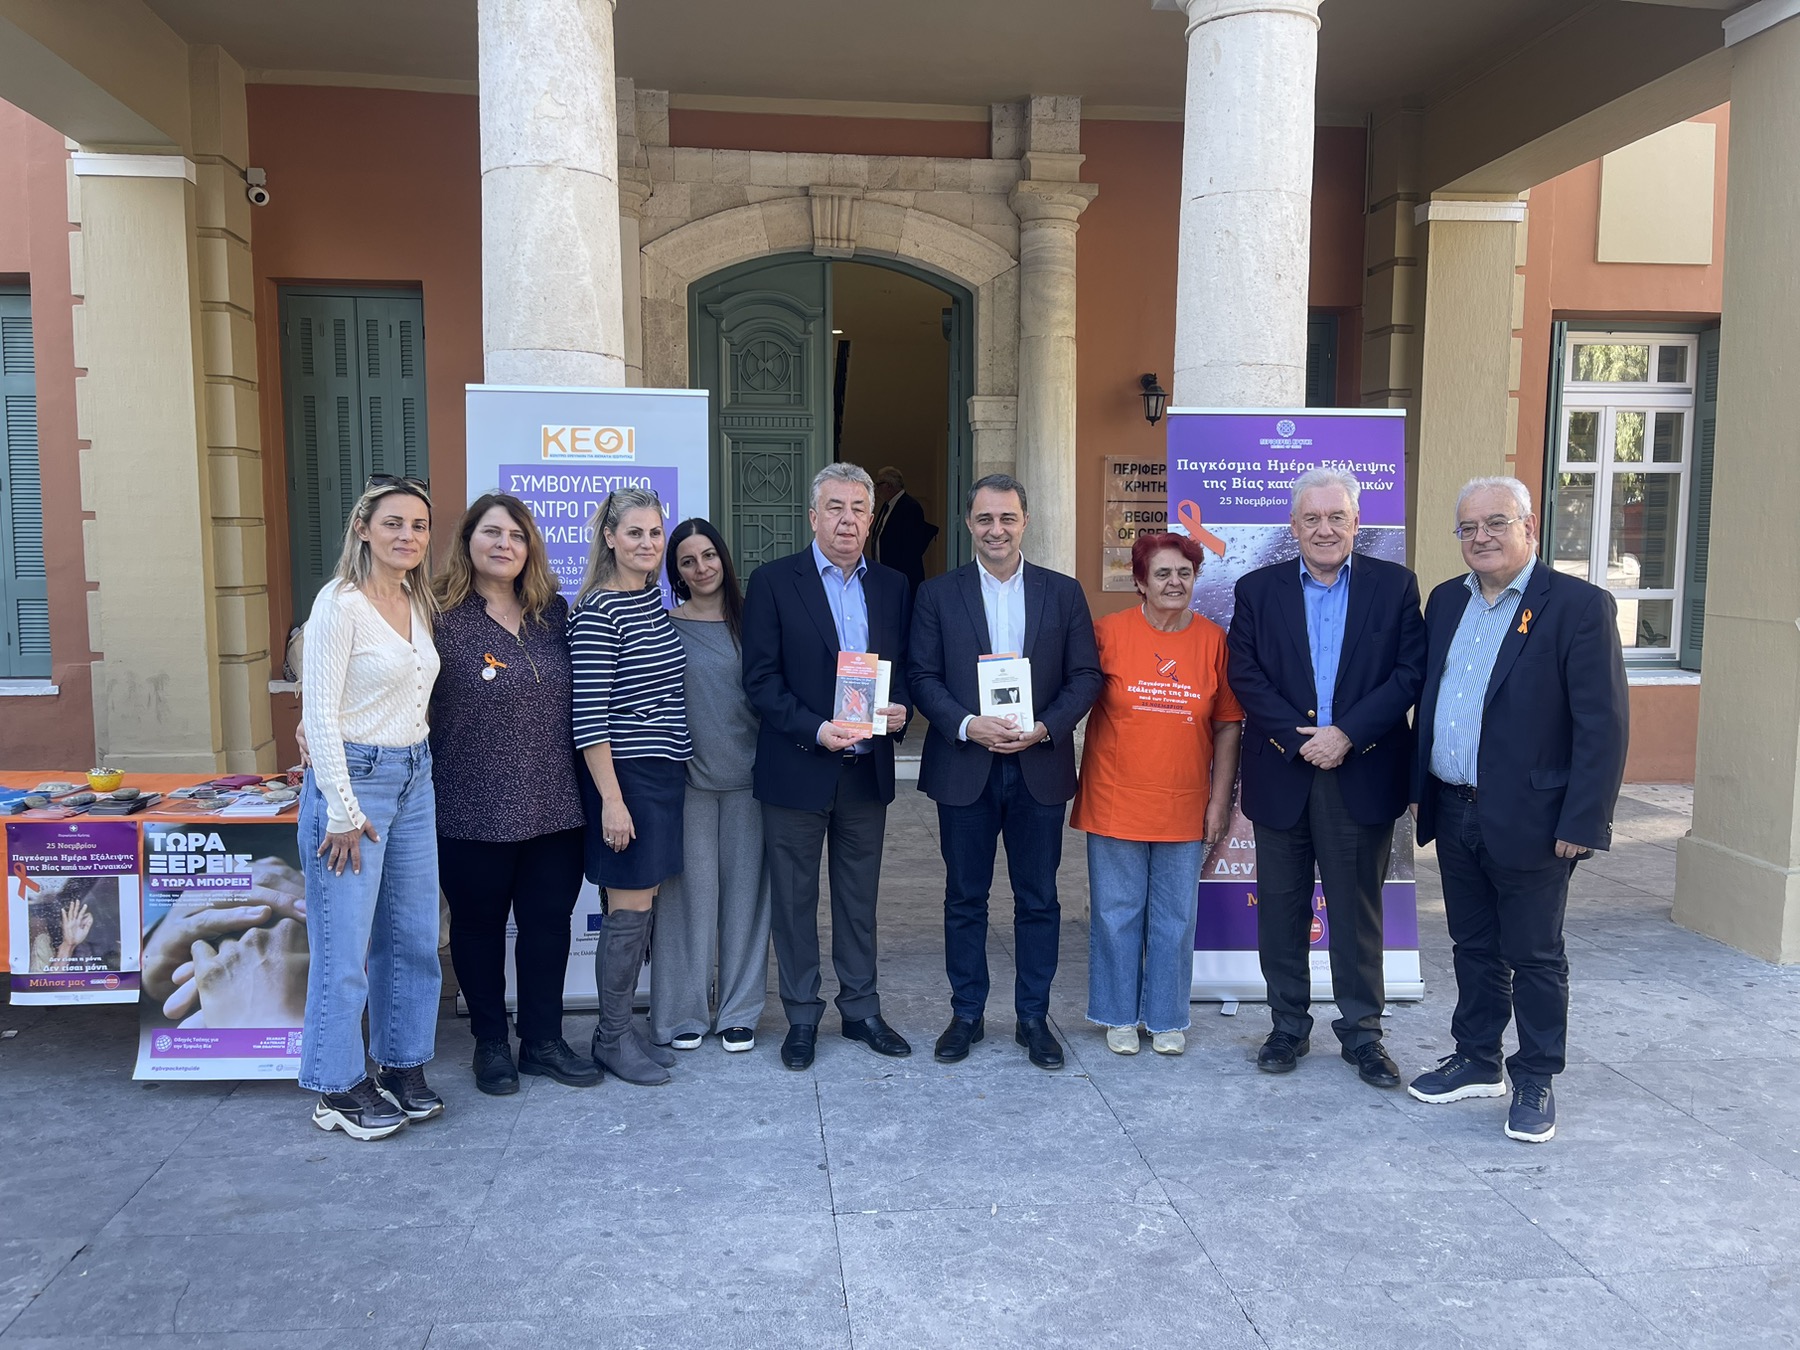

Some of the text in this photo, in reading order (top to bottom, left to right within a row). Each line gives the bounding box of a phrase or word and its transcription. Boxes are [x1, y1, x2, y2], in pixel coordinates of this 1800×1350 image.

[1114, 464, 1167, 475] ΠΕΡΙΦΕΡ
[1176, 459, 1395, 474] Παγκόσμια Ημέρα Εξάλειψης
[510, 475, 650, 492] ΣΥΜΒΟΥΛΕΥΤΙΚΟ
[1125, 481, 1167, 492] ΚΡΗΤΗ
[1203, 480, 1227, 491] της
[1232, 478, 1264, 491] Βίας
[1220, 497, 1288, 507] 25 Νοεμβρίου
[524, 501, 578, 518] ΕΝΤΡΟ
[1118, 528, 1134, 539] OF
[550, 567, 584, 575] 341387
[1128, 686, 1166, 696] Εξάλειψης
[149, 833, 226, 852] ΤΩΡΑ
[149, 854, 252, 873] ΞΕΡΕΙΣ
[1214, 859, 1254, 874] Δεν
[197, 878, 250, 886] ΜΠΟΡΕΙΣ
[85, 964, 107, 972] μόνη
[29, 979, 65, 987] Μίλησε
